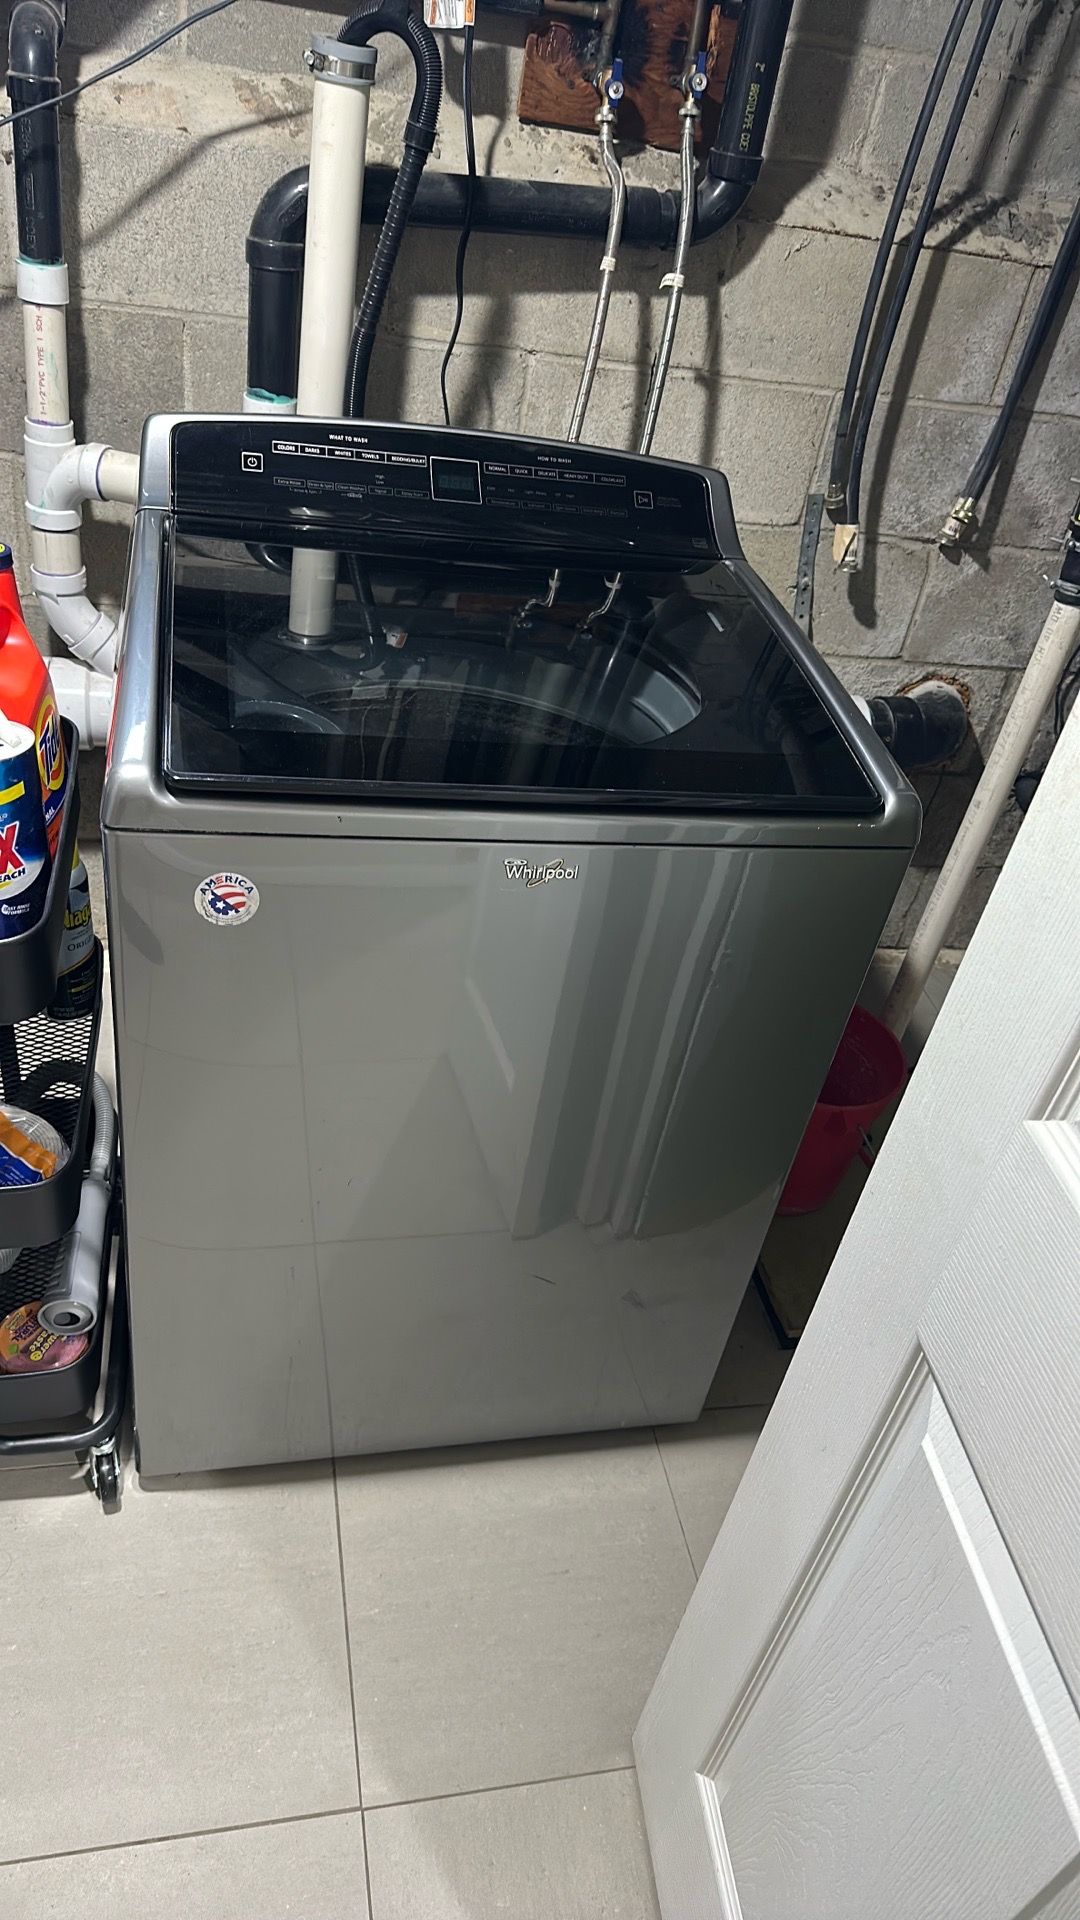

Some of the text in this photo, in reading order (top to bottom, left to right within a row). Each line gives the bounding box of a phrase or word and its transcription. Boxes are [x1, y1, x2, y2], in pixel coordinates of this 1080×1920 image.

[36, 346, 44, 366] TYPE
[277, 444, 295, 452] COLORS
[353, 436, 368, 444] WASH
[505, 864, 578, 883] Whirlpool
[199, 875, 254, 896] AMERICA
